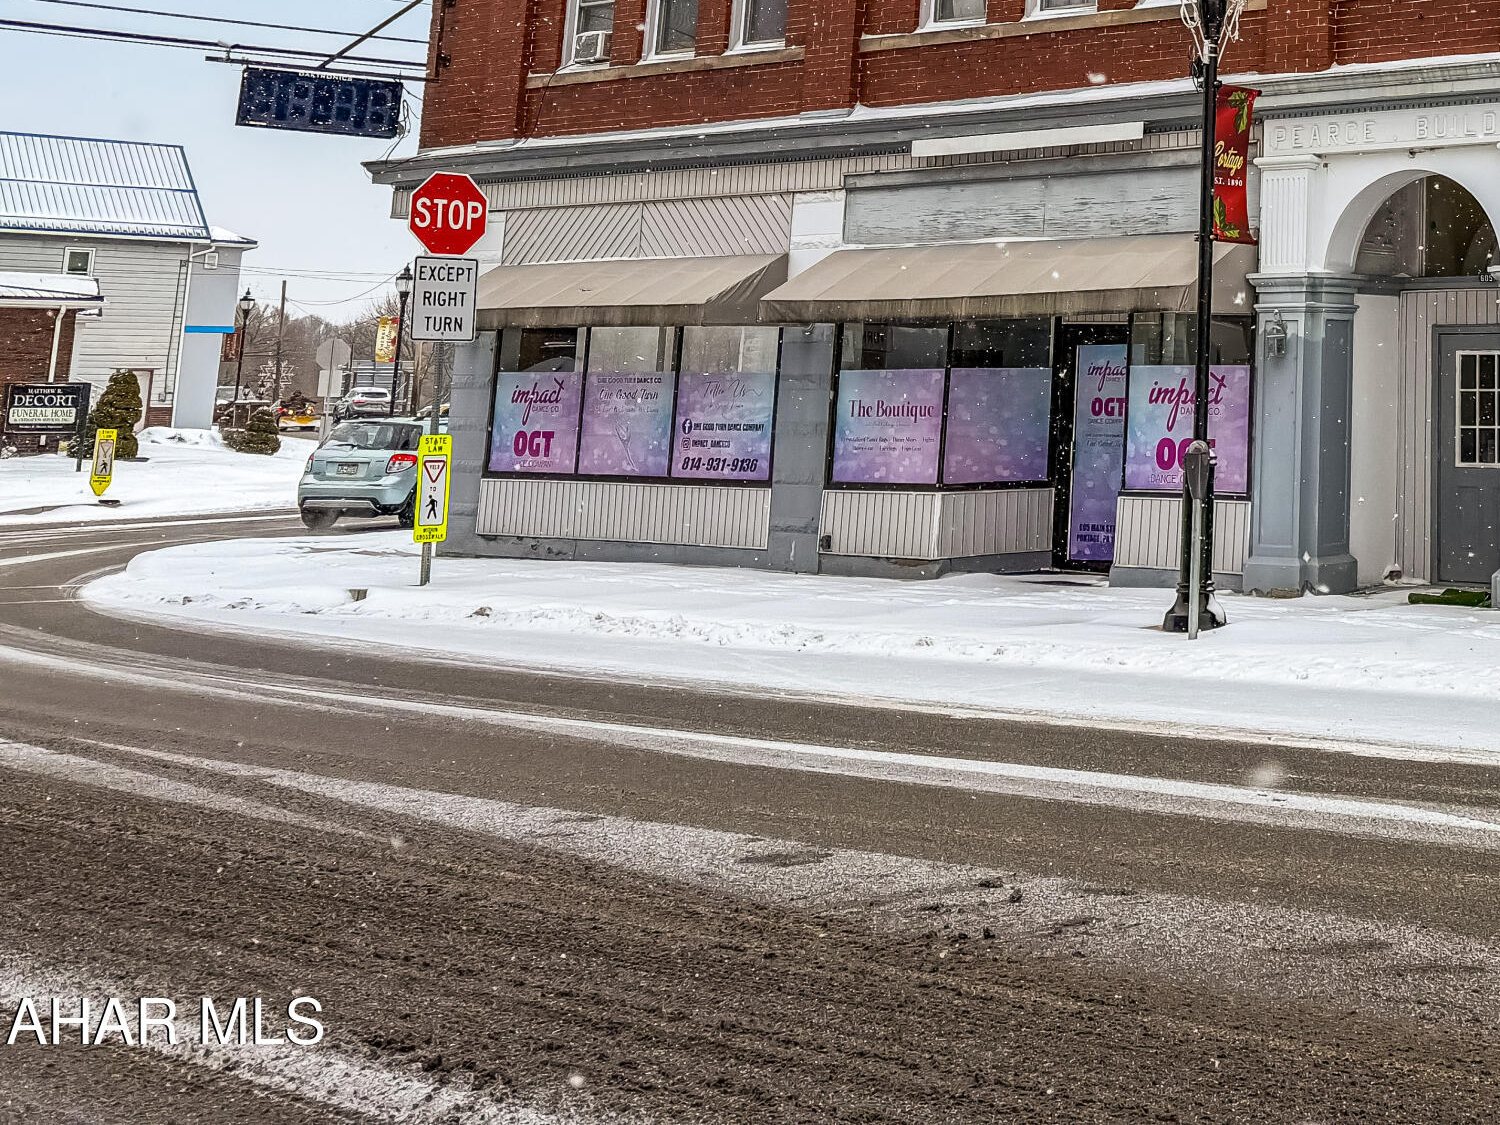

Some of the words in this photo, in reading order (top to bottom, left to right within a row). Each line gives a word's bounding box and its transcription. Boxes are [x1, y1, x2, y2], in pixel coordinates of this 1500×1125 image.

[1273, 120, 1377, 148] PEARCE
[1214, 140, 1244, 176] Portage
[1214, 177, 1225, 185] ST.
[1227, 178, 1243, 186] 1890
[414, 197, 483, 231] STOP
[419, 265, 473, 282] EXCEPT
[422, 291, 467, 307] RIGHT
[424, 316, 463, 332] TURN
[1087, 360, 1127, 392] impac
[13, 394, 77, 406] DECORT
[511, 377, 564, 426] impact
[616, 388, 638, 400] Good
[640, 388, 659, 400] Turn
[12, 408, 49, 418] FUNERAL
[51, 408, 73, 418] HOME
[849, 399, 872, 418] The
[876, 399, 934, 423] Boutique
[425, 437, 447, 445] STATE
[428, 445, 443, 453] LAW
[514, 430, 555, 457] OGT
[682, 456, 758, 472] 814-931-9136
[1150, 474, 1176, 484] DANCE
